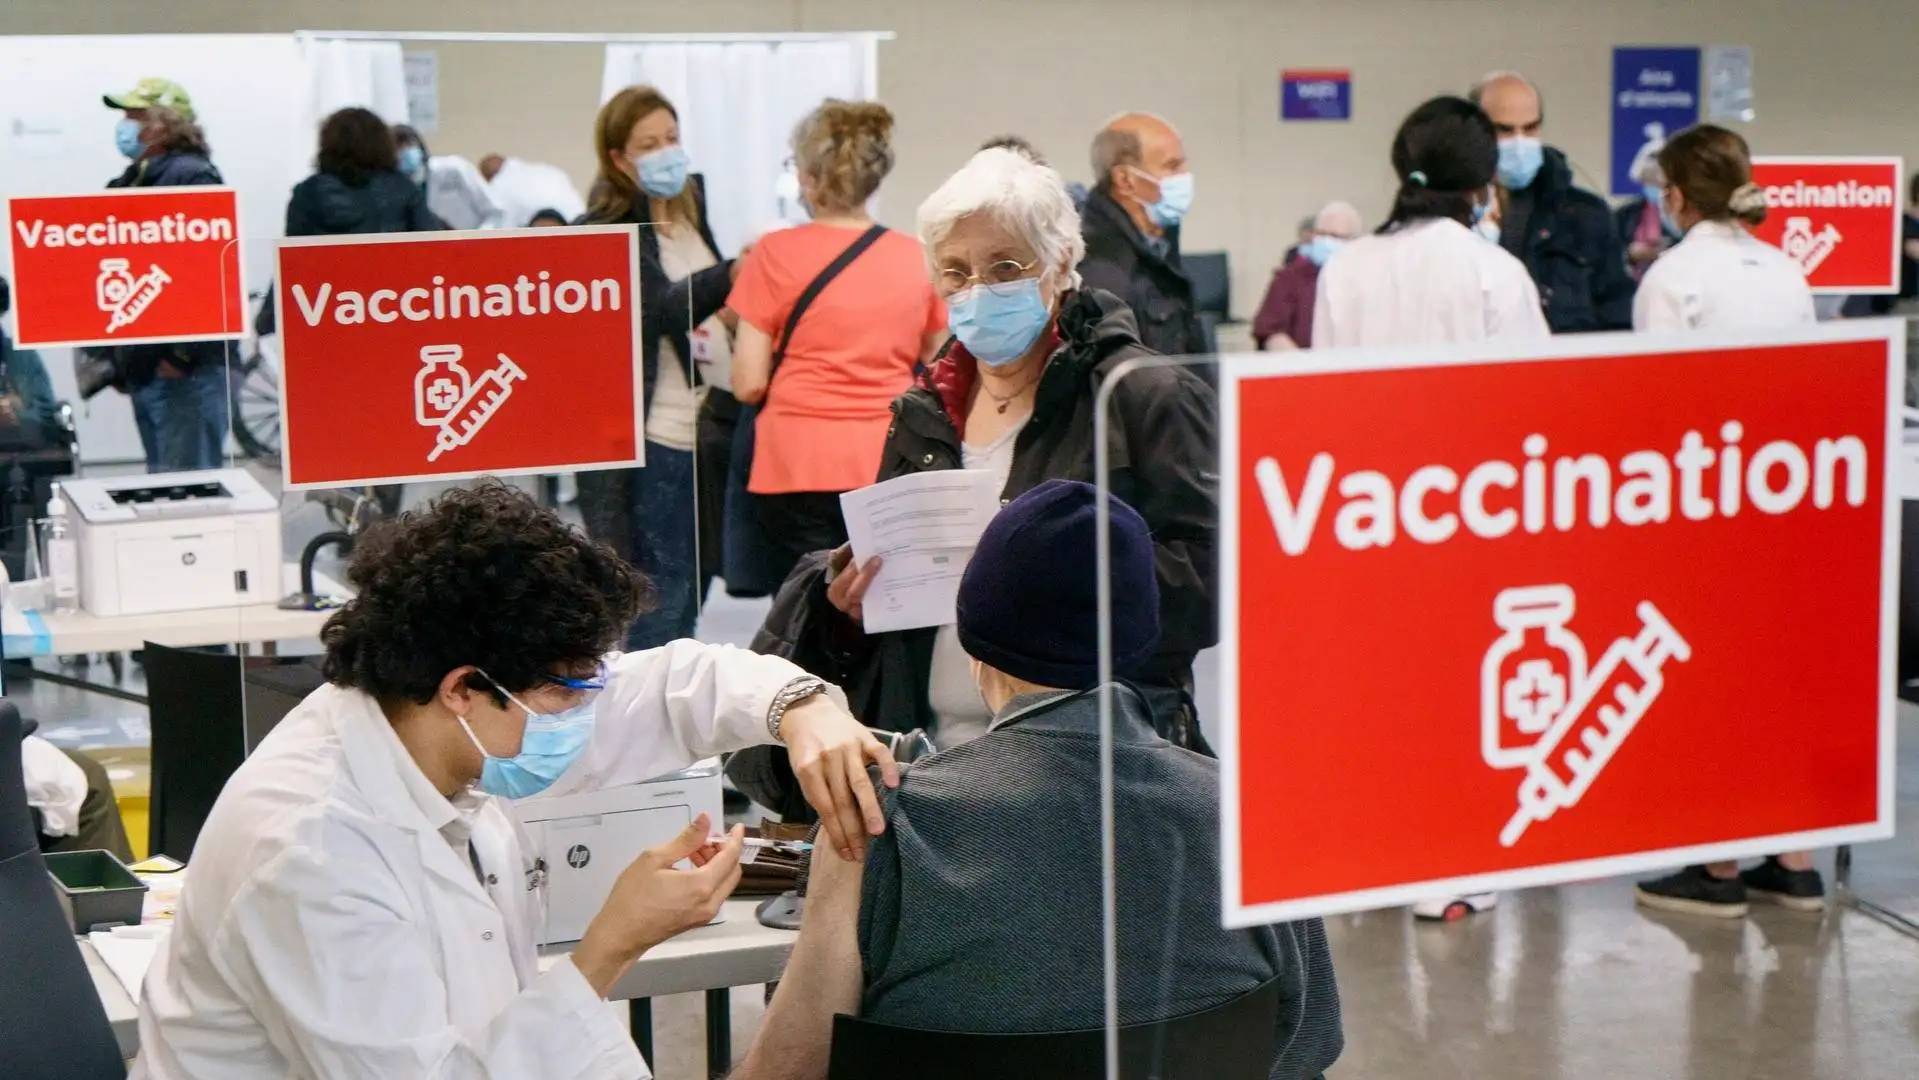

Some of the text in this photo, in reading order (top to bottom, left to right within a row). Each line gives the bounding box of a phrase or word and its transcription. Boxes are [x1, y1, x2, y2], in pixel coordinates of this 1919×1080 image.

[1763, 179, 1893, 208] ccination
[16, 211, 232, 249] Vaccination
[291, 270, 621, 327] Vaccination
[1255, 421, 1867, 556] Vaccination
